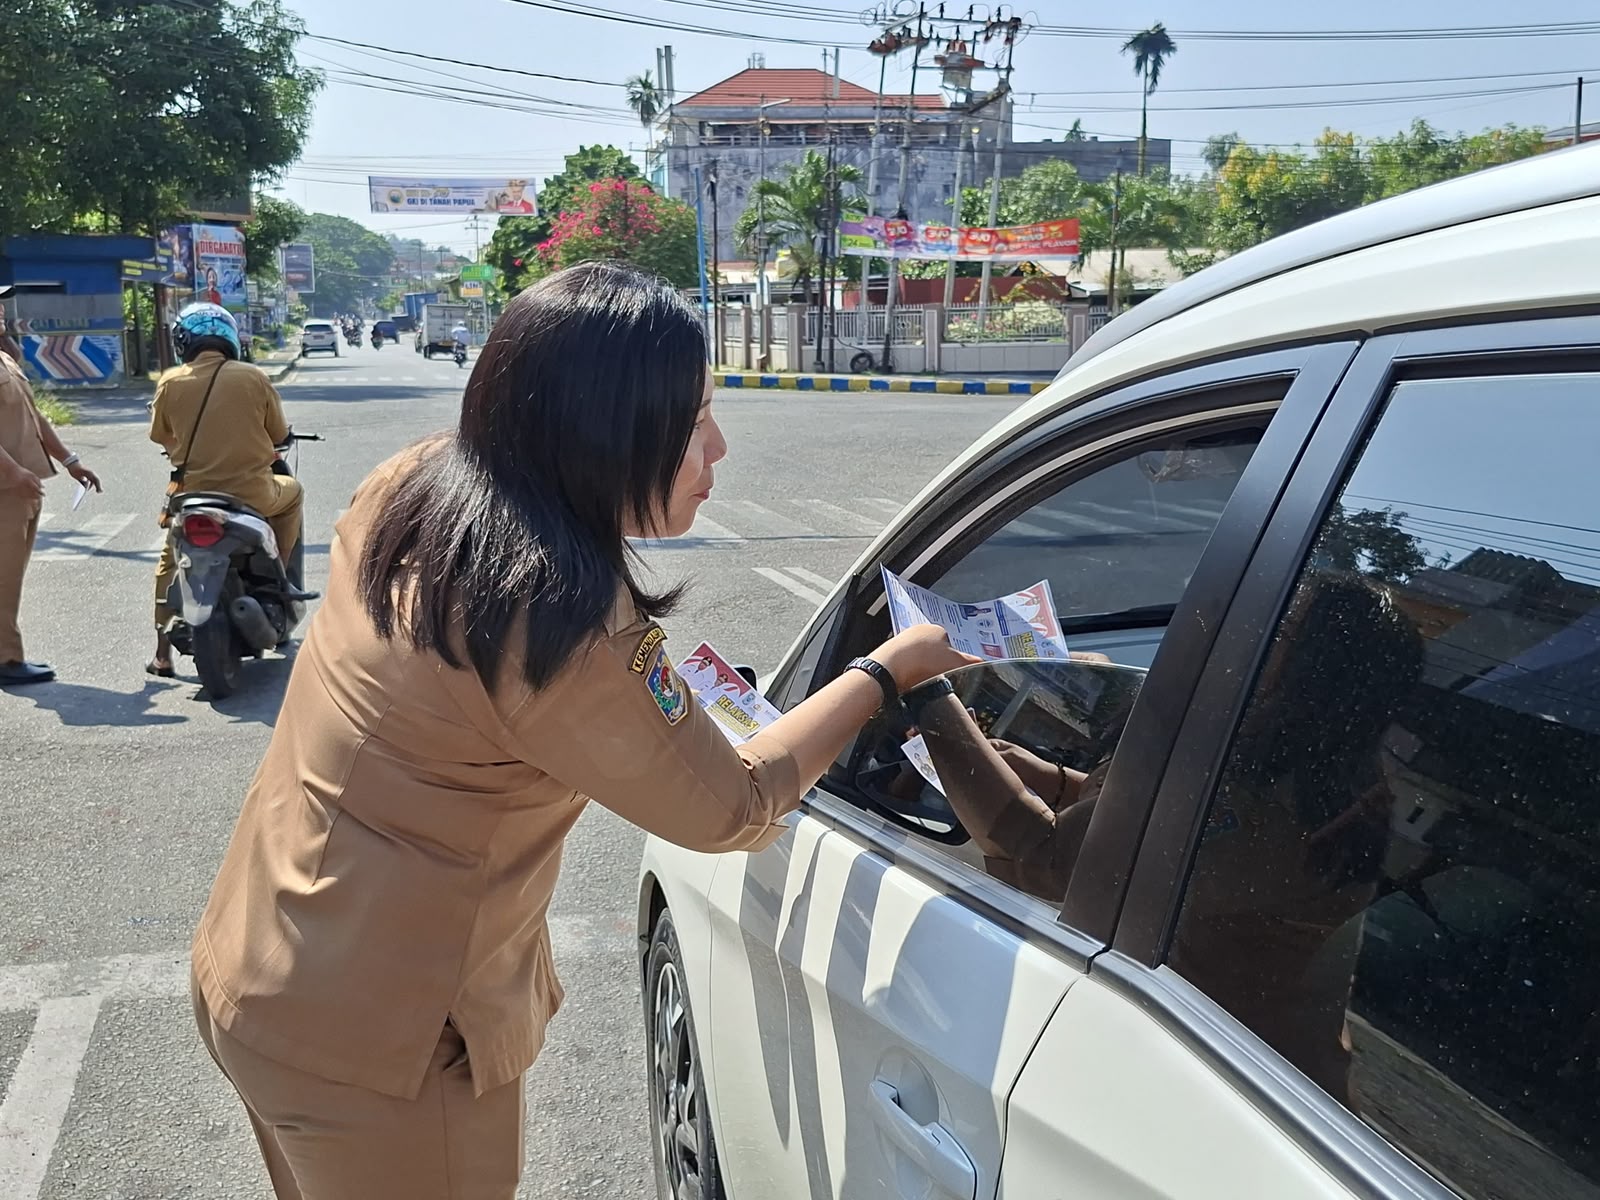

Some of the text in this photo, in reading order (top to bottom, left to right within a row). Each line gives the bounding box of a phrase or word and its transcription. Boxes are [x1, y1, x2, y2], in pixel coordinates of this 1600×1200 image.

[420, 198, 427, 206] DI
[429, 198, 451, 206] TANAH
[453, 198, 475, 206] PAPUA
[715, 693, 760, 731] RELAKSASI
